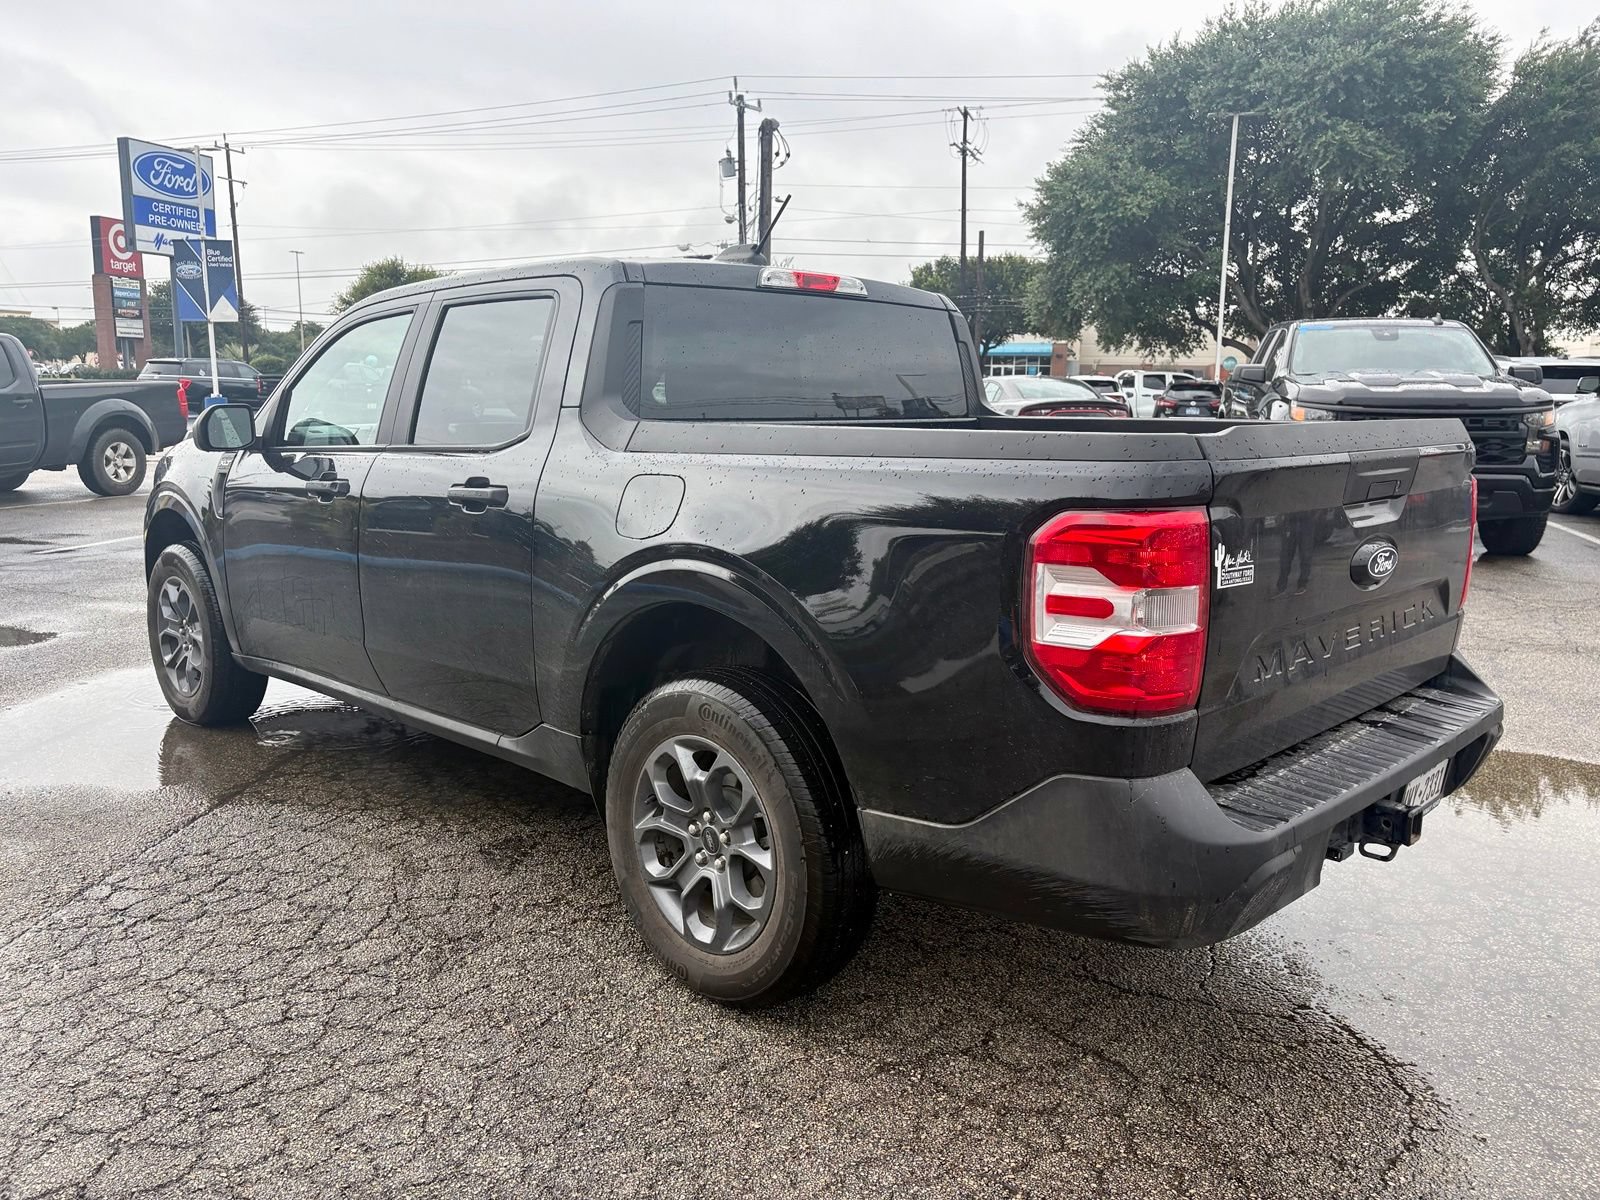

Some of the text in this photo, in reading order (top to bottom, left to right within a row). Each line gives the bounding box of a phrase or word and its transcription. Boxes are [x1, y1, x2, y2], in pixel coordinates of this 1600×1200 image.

[150, 157, 197, 193] Ford
[152, 202, 198, 218] CERTIFIED
[148, 214, 202, 231] PRE-OWNED
[206, 248, 220, 256] Blue
[207, 255, 233, 263] Certified
[110, 258, 137, 273] target
[1373, 552, 1395, 573] Ford
[1254, 599, 1434, 683] MAVERICK
